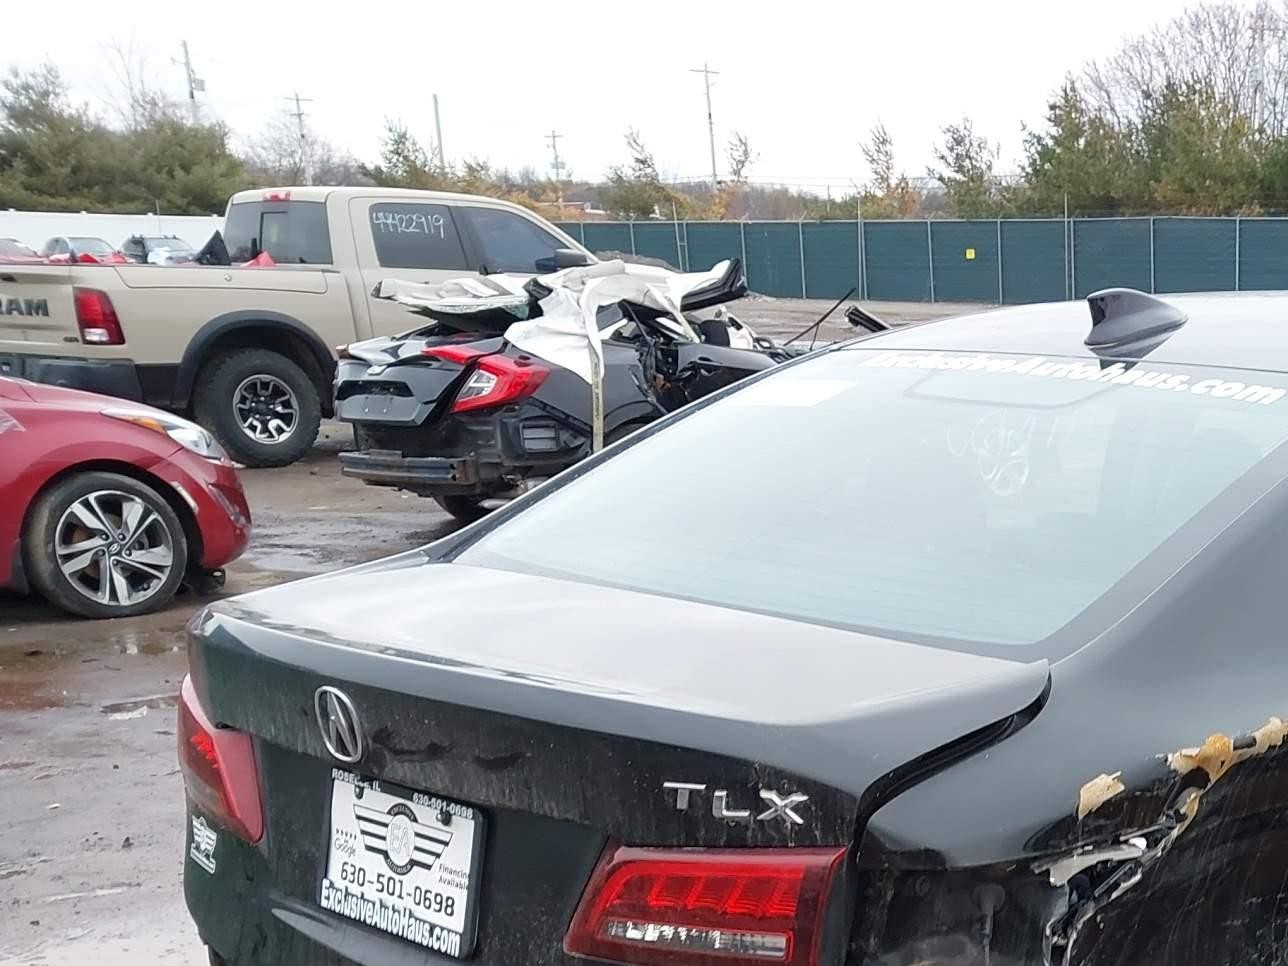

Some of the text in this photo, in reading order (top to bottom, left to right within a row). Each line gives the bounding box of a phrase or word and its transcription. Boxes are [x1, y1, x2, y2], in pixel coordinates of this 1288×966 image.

[0, 297, 49, 316] AM
[412, 792, 474, 820] 630-501-0698
[663, 781, 809, 825] TLX
[340, 861, 456, 917] 630-501-0698
[320, 877, 461, 958] ExclusiveAutoHaus.com
